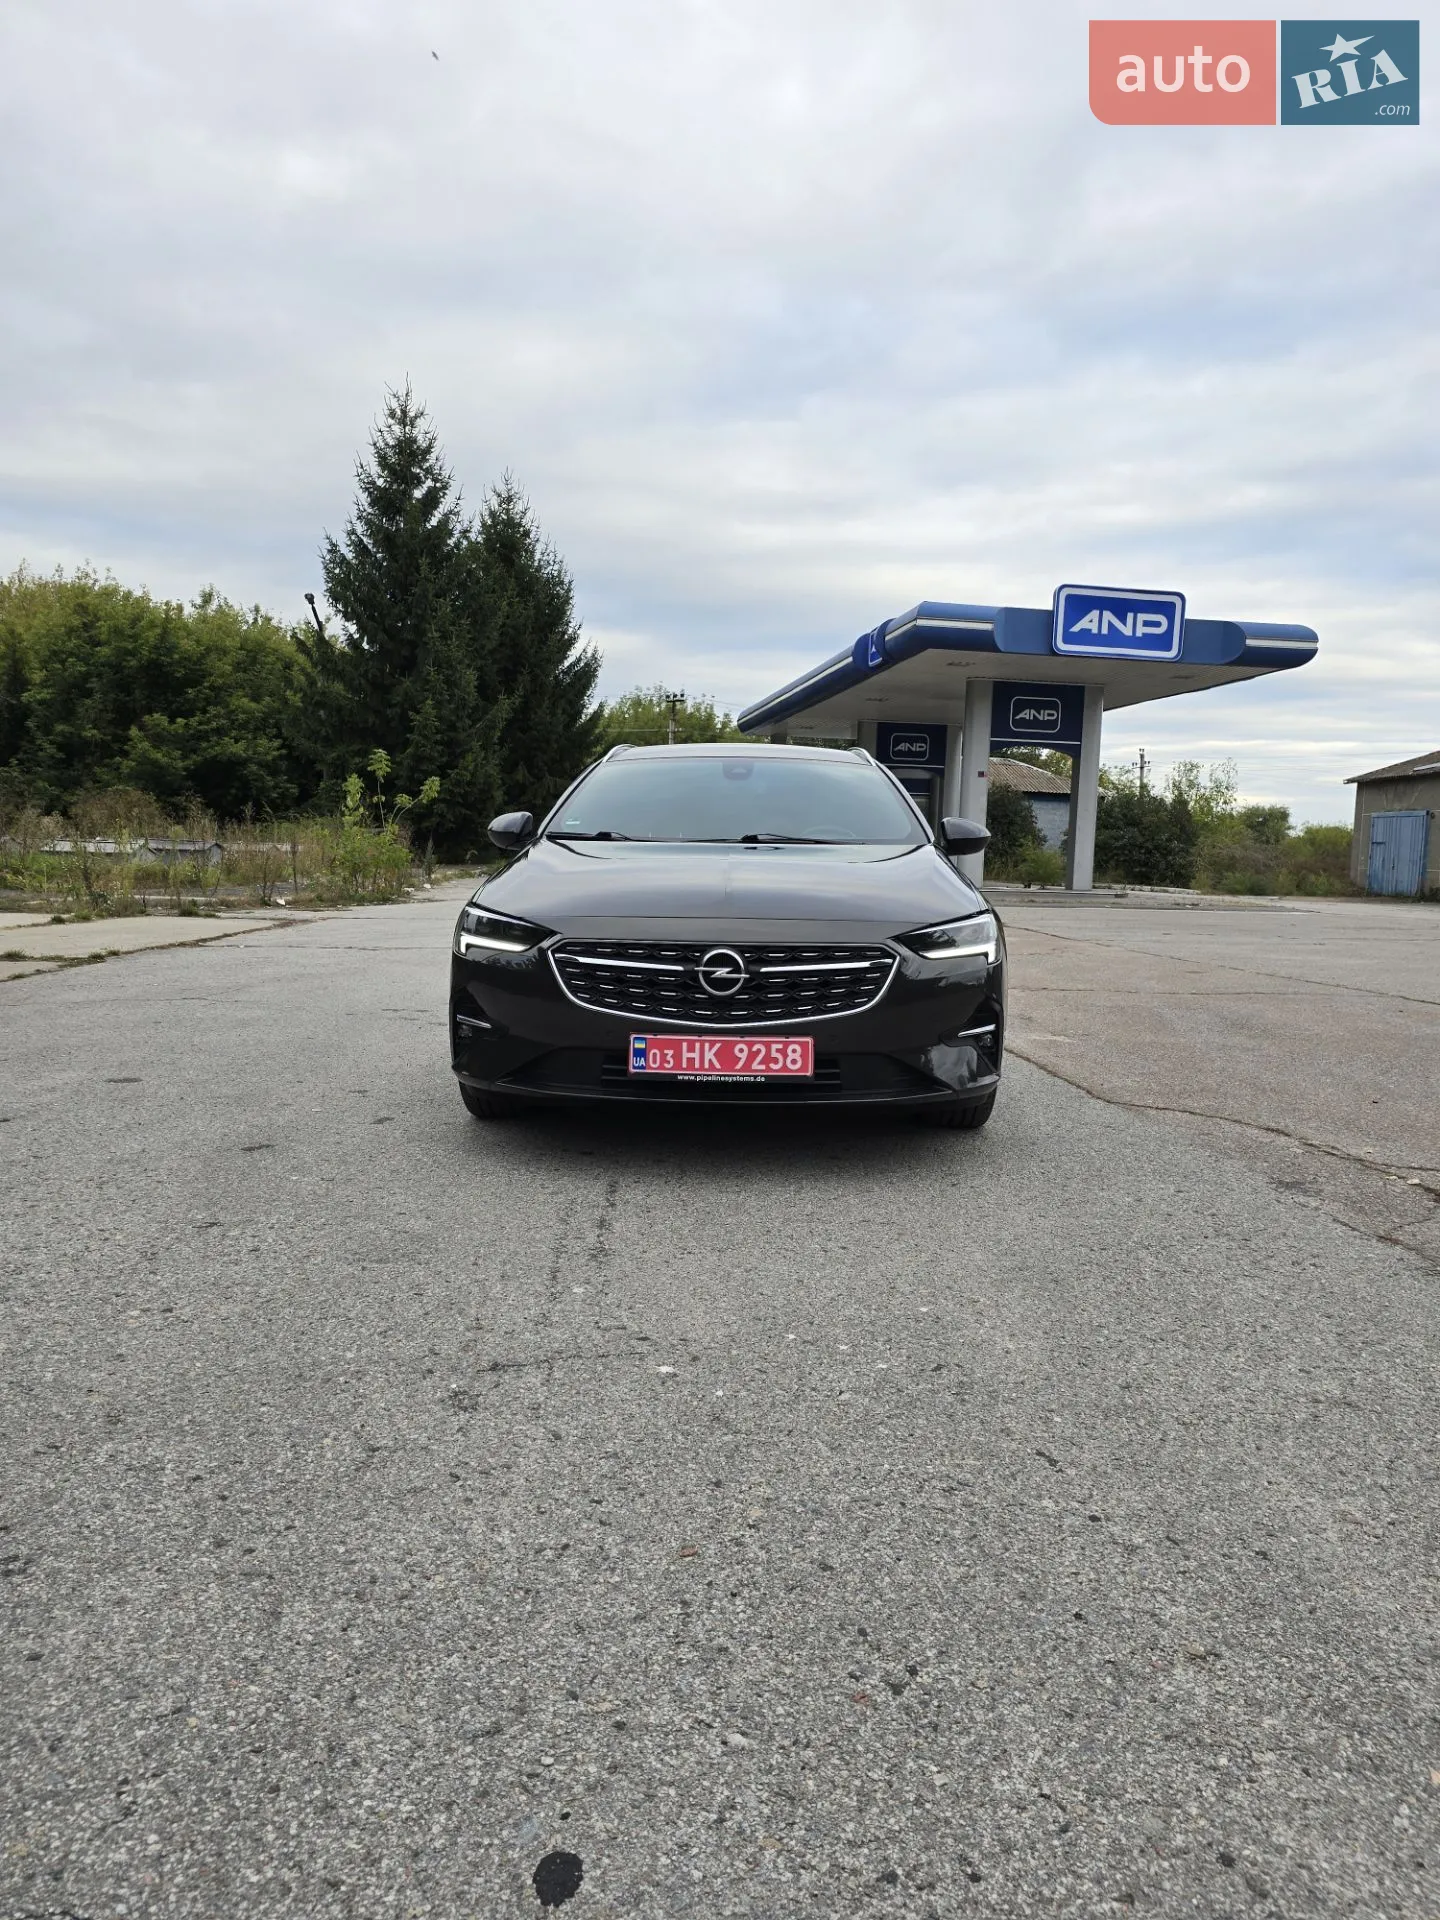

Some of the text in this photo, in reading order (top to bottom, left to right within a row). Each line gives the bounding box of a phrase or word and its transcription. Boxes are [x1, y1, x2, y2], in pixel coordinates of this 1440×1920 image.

[1069, 609, 1168, 637] ANP
[1014, 708, 1058, 721] ANP
[893, 742, 927, 751] ANP
[649, 1042, 802, 1070] 03 HK 9258
[633, 1057, 646, 1067] UA
[677, 1074, 766, 1082] www.pipelinesystems.de
